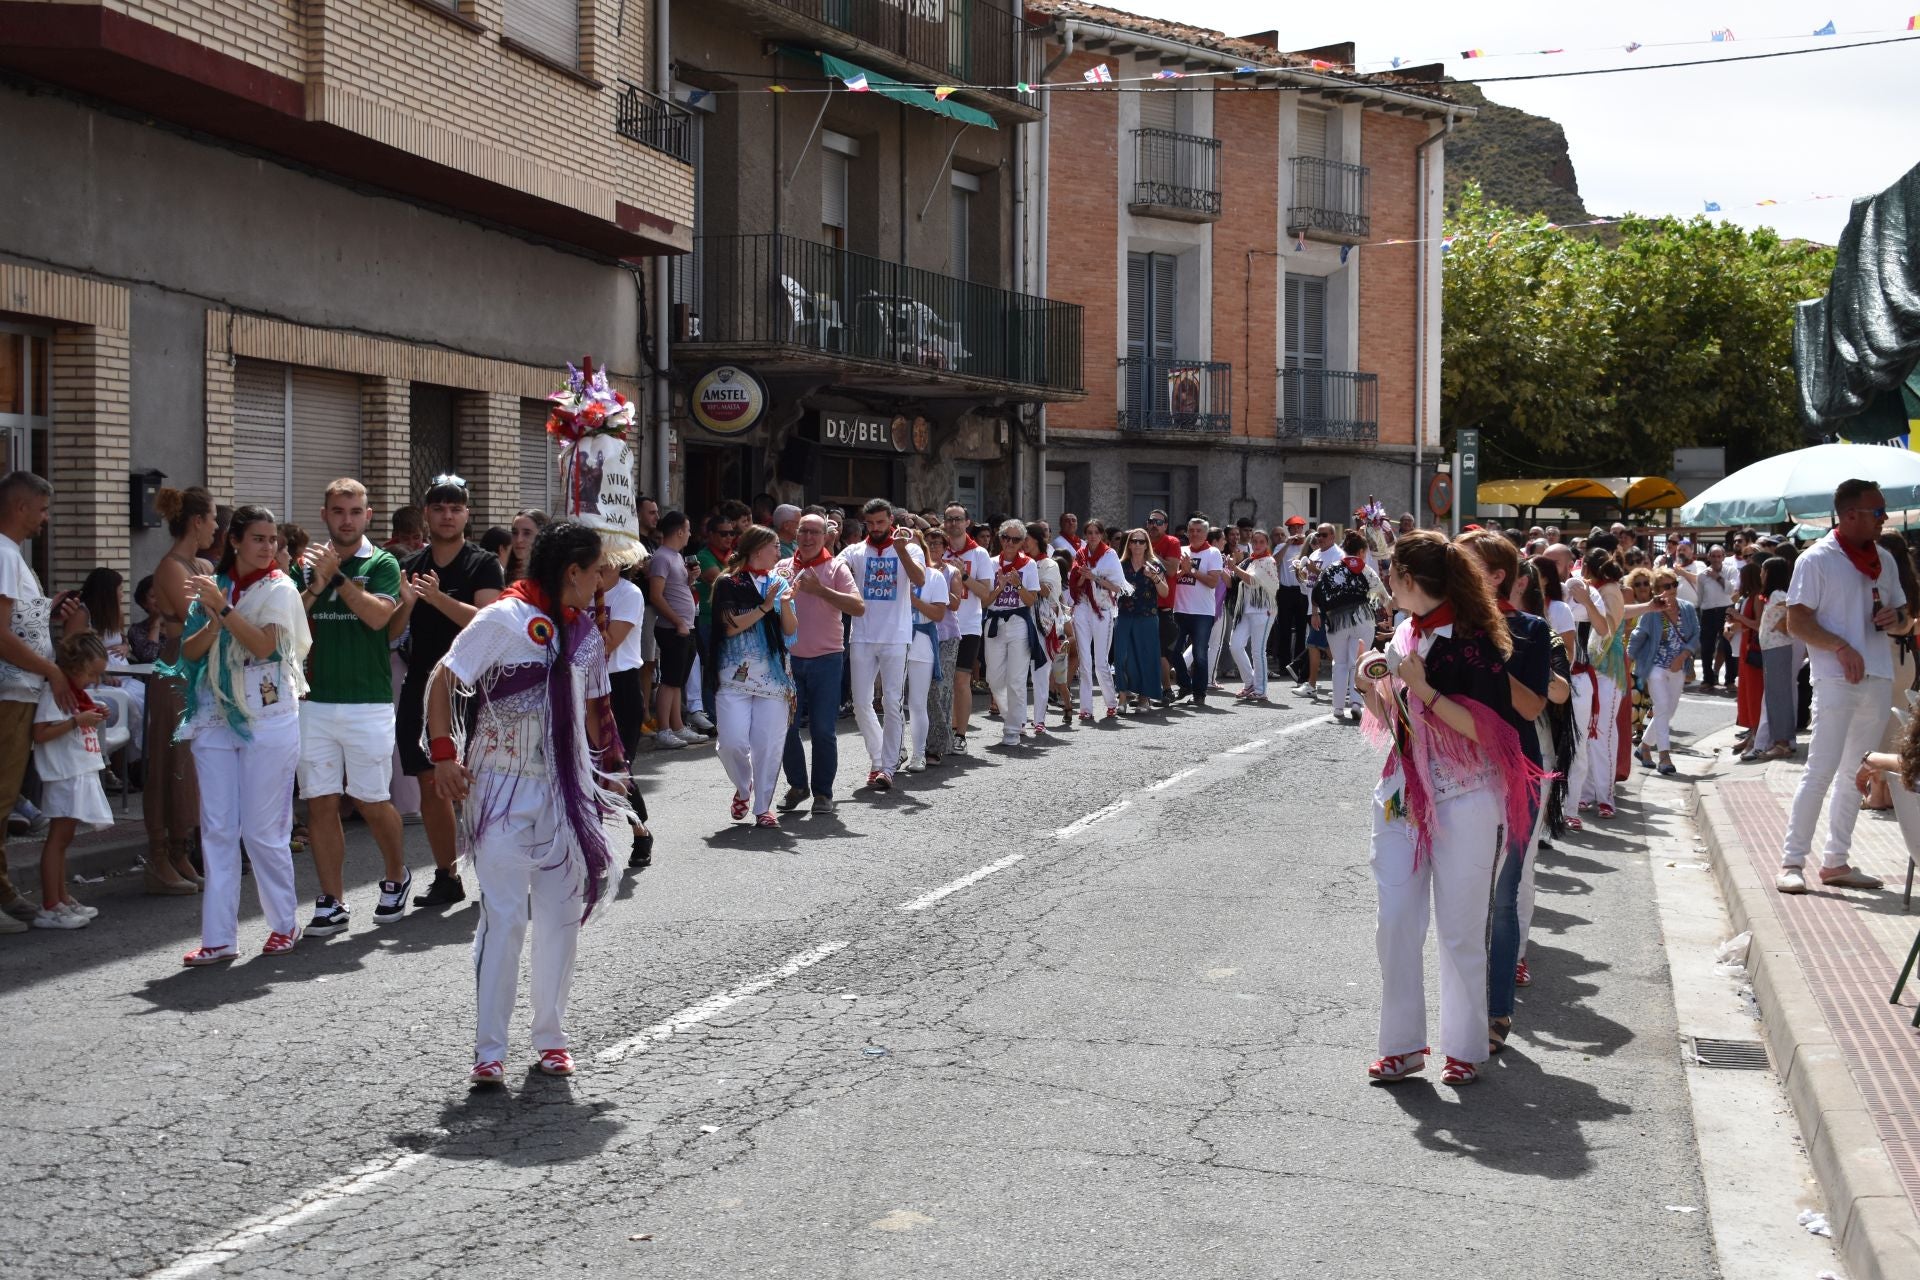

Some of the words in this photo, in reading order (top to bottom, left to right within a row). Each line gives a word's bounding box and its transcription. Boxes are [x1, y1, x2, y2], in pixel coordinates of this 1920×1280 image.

[703, 389, 747, 401] AMSTEL
[601, 493, 630, 507] SANTA
[871, 560, 894, 569] POM
[869, 574, 893, 583] POM
[868, 588, 893, 597] POM
[998, 597, 1016, 605] POM
